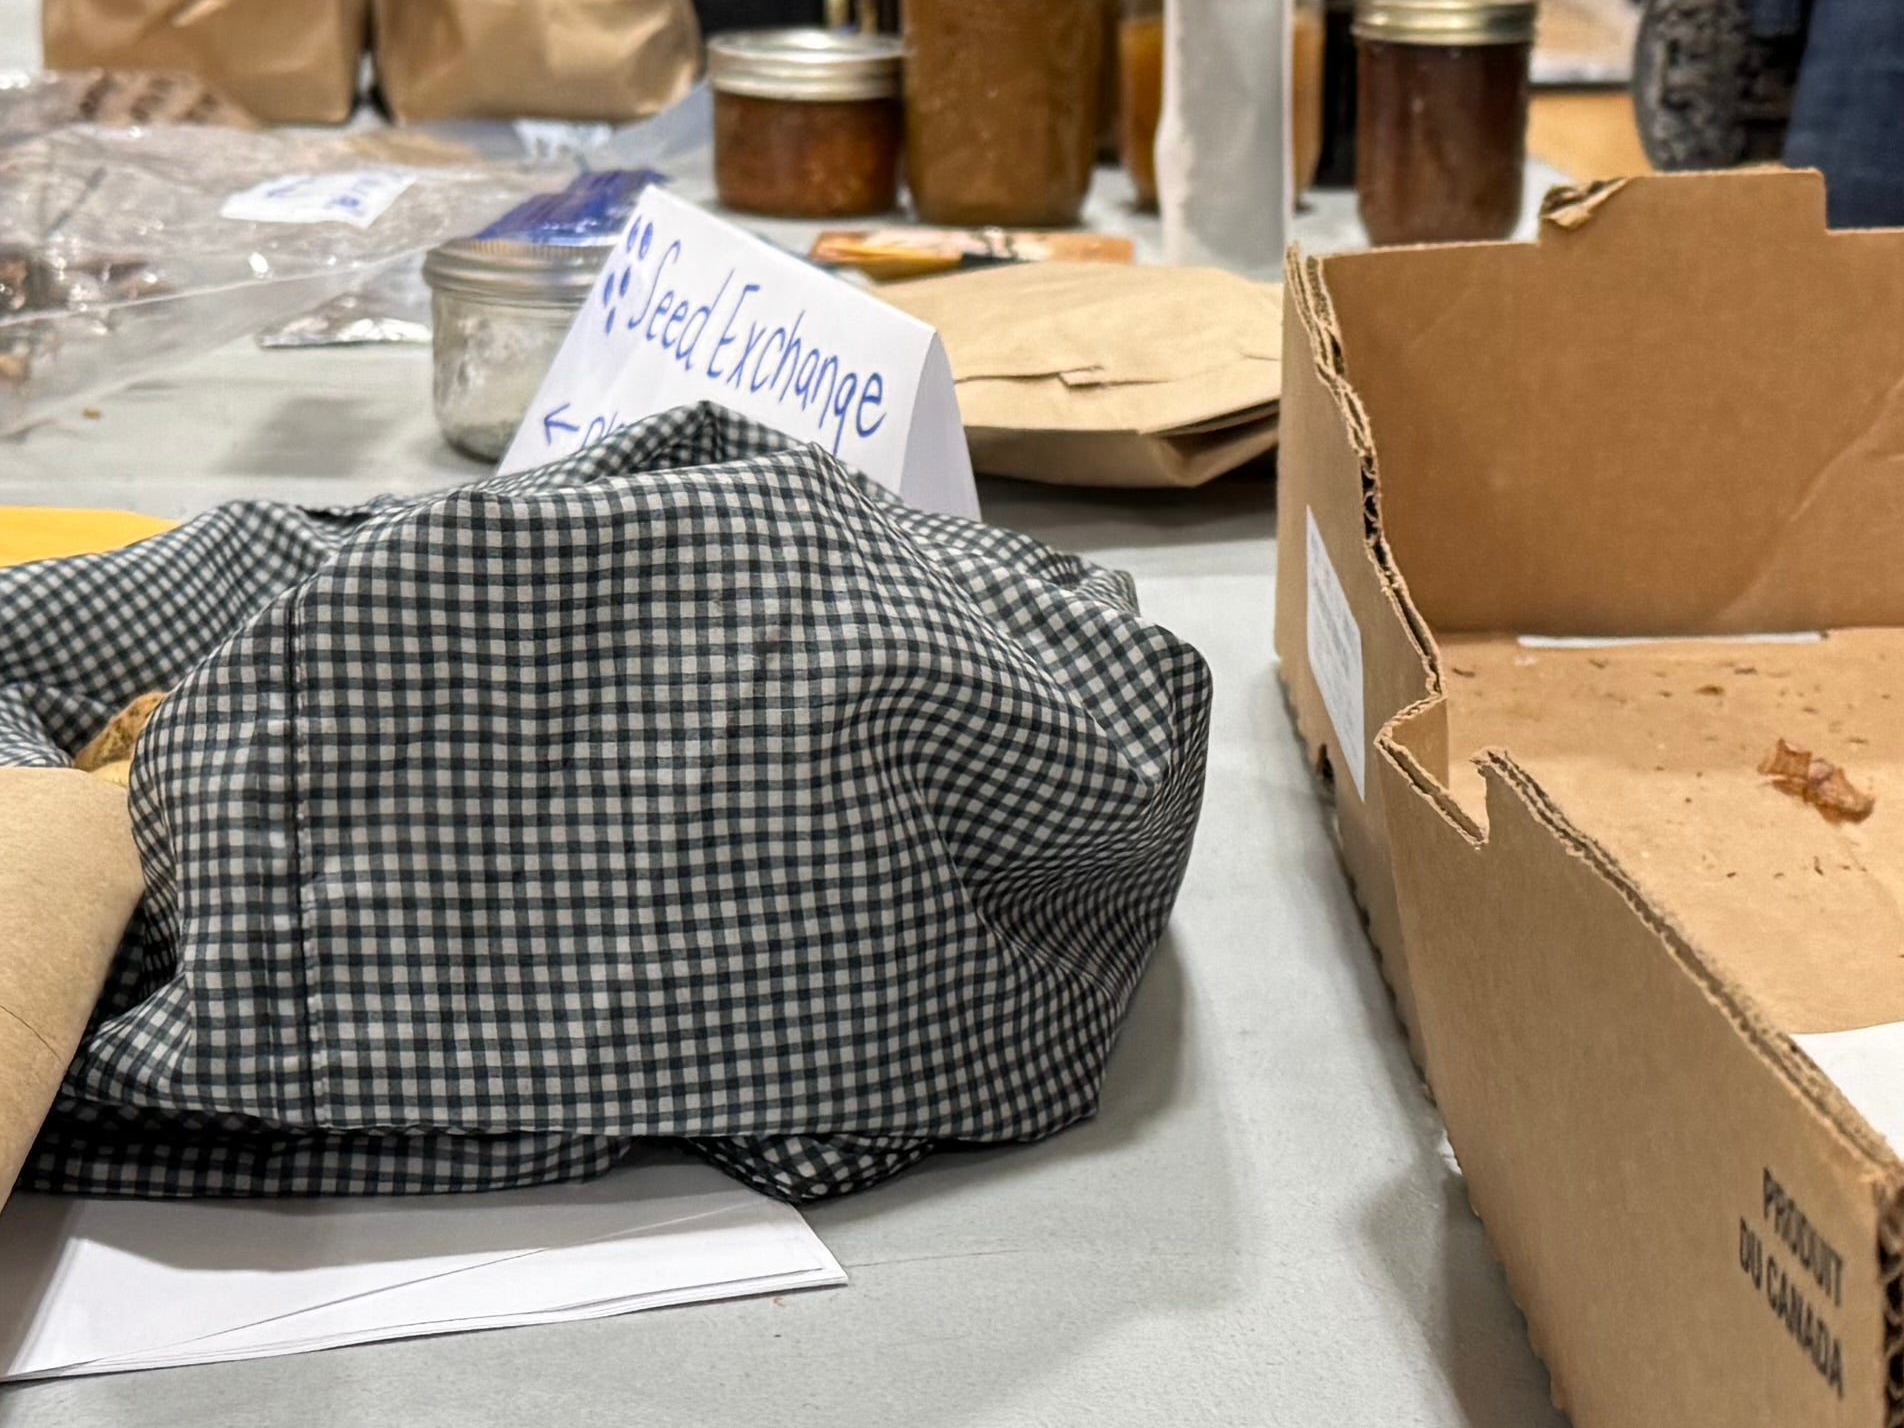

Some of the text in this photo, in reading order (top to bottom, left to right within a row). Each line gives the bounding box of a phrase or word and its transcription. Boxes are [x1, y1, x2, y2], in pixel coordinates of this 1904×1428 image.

[627, 239, 887, 458] Seed Exchange
[1739, 1217, 1844, 1400] DU CANADA
